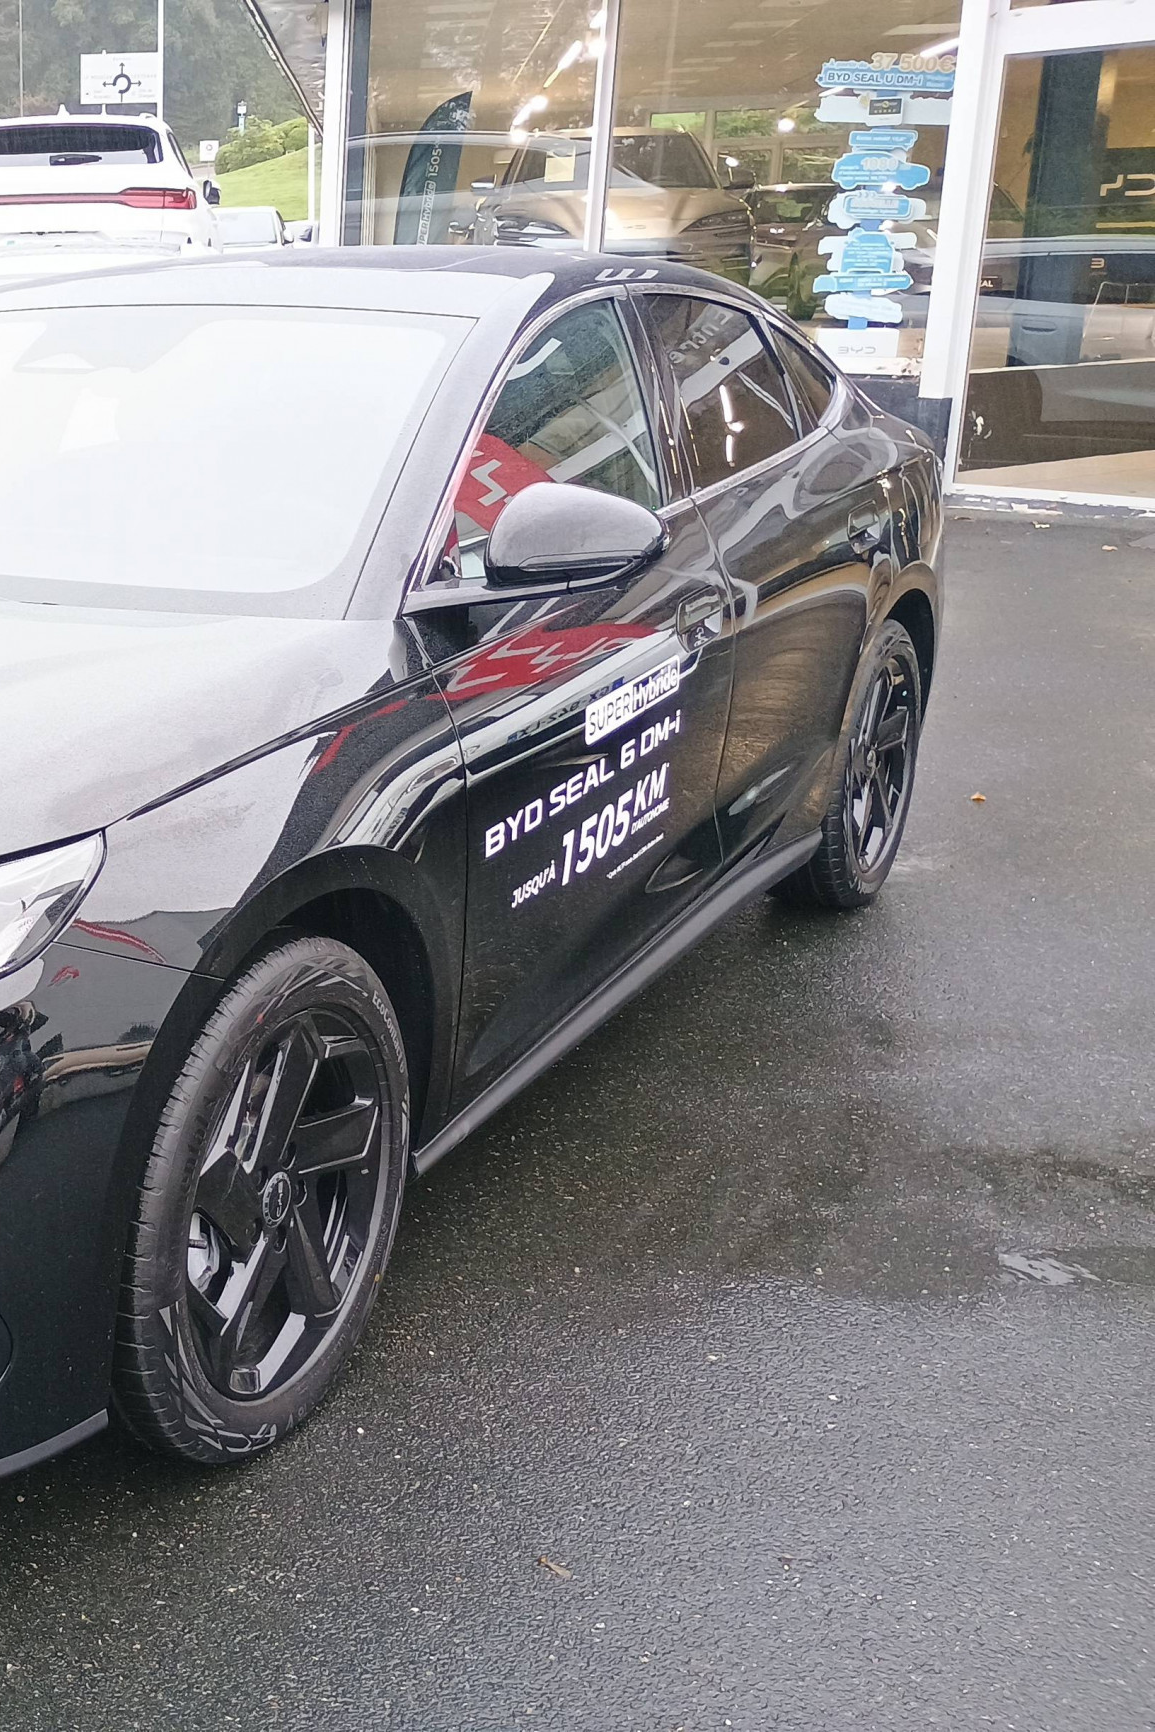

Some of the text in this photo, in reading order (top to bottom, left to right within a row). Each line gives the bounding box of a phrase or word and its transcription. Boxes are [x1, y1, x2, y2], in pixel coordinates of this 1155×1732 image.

[871, 53, 898, 71] 37
[900, 54, 956, 73] 500€
[827, 72, 851, 82] BYD
[853, 73, 883, 84] SEAL
[885, 75, 894, 84] U
[896, 75, 924, 86] DM-i
[837, 346, 877, 354] BYD
[485, 798, 543, 858] BYD
[549, 755, 615, 816] SEAL
[620, 738, 636, 770] 6
[640, 709, 681, 757] DM-i
[561, 788, 634, 887] 1505
